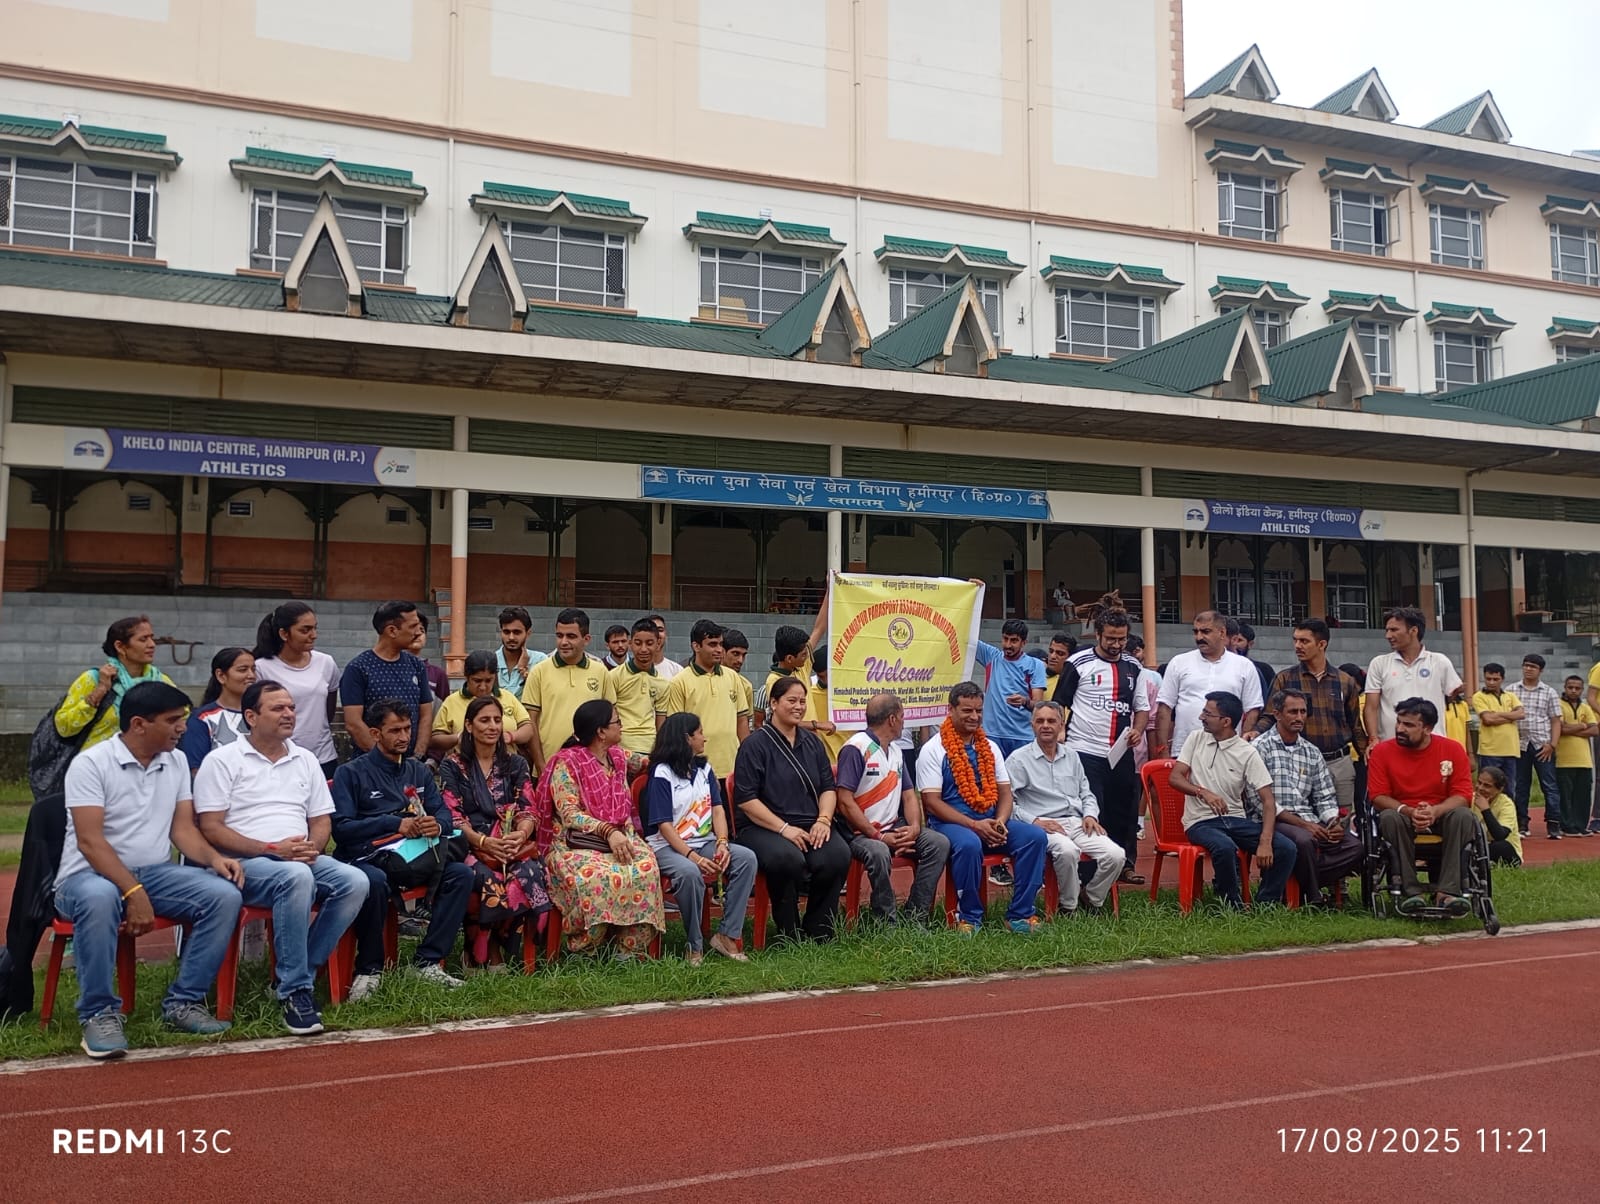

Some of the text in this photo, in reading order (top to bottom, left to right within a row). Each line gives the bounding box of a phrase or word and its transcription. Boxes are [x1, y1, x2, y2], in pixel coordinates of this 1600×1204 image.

[122, 435, 366, 465] KHELO INDIA CENTRE, HAMIRPUR (H.P.)
[200, 460, 287, 477] ATHLETICS
[676, 469, 715, 486] जिला
[722, 475, 751, 491] युवा
[757, 474, 787, 490] सेवा
[793, 478, 816, 494] एवं
[822, 478, 851, 494] खेल
[857, 481, 901, 497] विभाग
[906, 485, 955, 503] हमीरपुर
[1212, 503, 1234, 516] खेलो
[1236, 504, 1261, 517] इंडिया
[1288, 508, 1318, 523] हमीरपुर
[1260, 522, 1311, 534] ATHLETICS
[863, 655, 936, 683] Welcome
